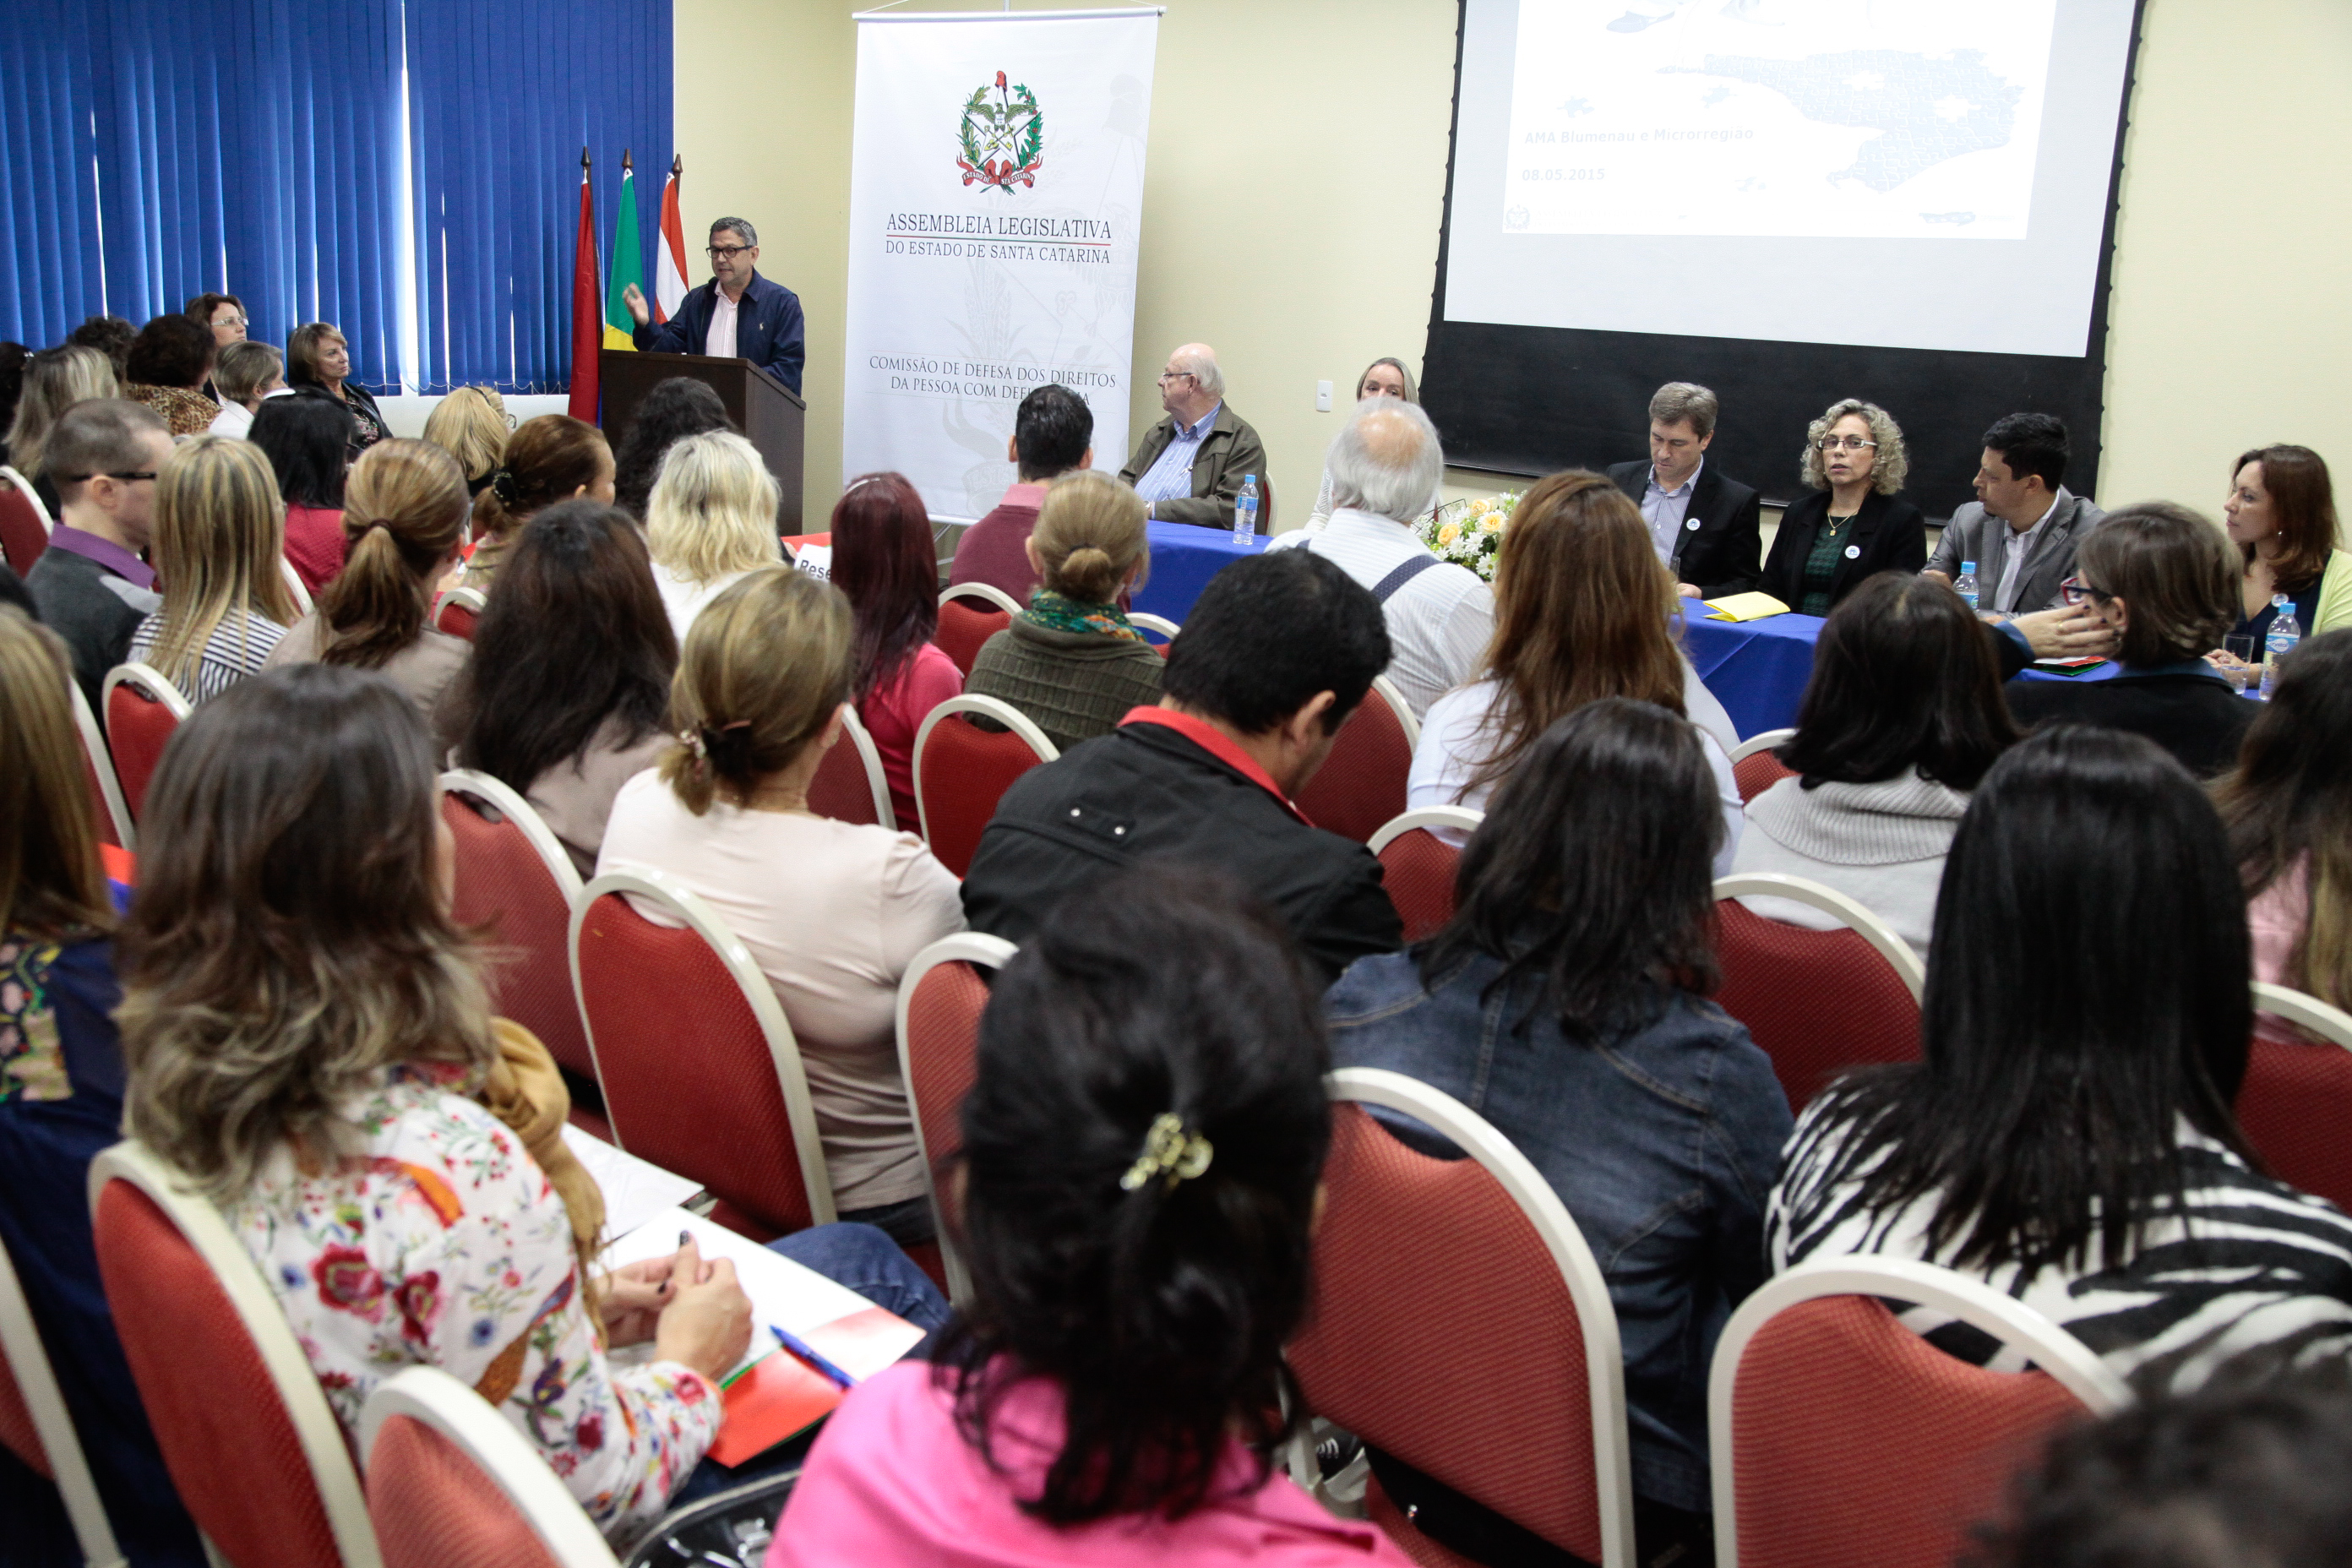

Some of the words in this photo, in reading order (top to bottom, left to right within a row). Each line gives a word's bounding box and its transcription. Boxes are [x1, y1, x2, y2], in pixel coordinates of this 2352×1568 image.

[1524, 131, 1557, 144] AMA
[1560, 129, 1636, 144] Blumenau
[1640, 132, 1649, 142] e
[1653, 125, 1754, 143] Microrregião
[1522, 167, 1605, 182] 08.05.2015
[886, 213, 993, 235] ASSEMBLEIA
[998, 216, 1112, 239] LEGISLATIVA
[885, 240, 905, 254] DO
[909, 241, 962, 257] ESTADO
[966, 243, 986, 259] DE
[990, 244, 1035, 260] SANTA
[1039, 247, 1110, 264] CATARINA
[869, 356, 939, 373] COMISSÃO
[943, 361, 960, 376] DE
[965, 362, 1013, 380] DEFESA
[1017, 367, 1046, 383] DOS
[1050, 369, 1116, 388] DIREITOS
[890, 376, 909, 390] DA
[913, 378, 961, 395] PESSOA
[963, 382, 997, 398] COM
